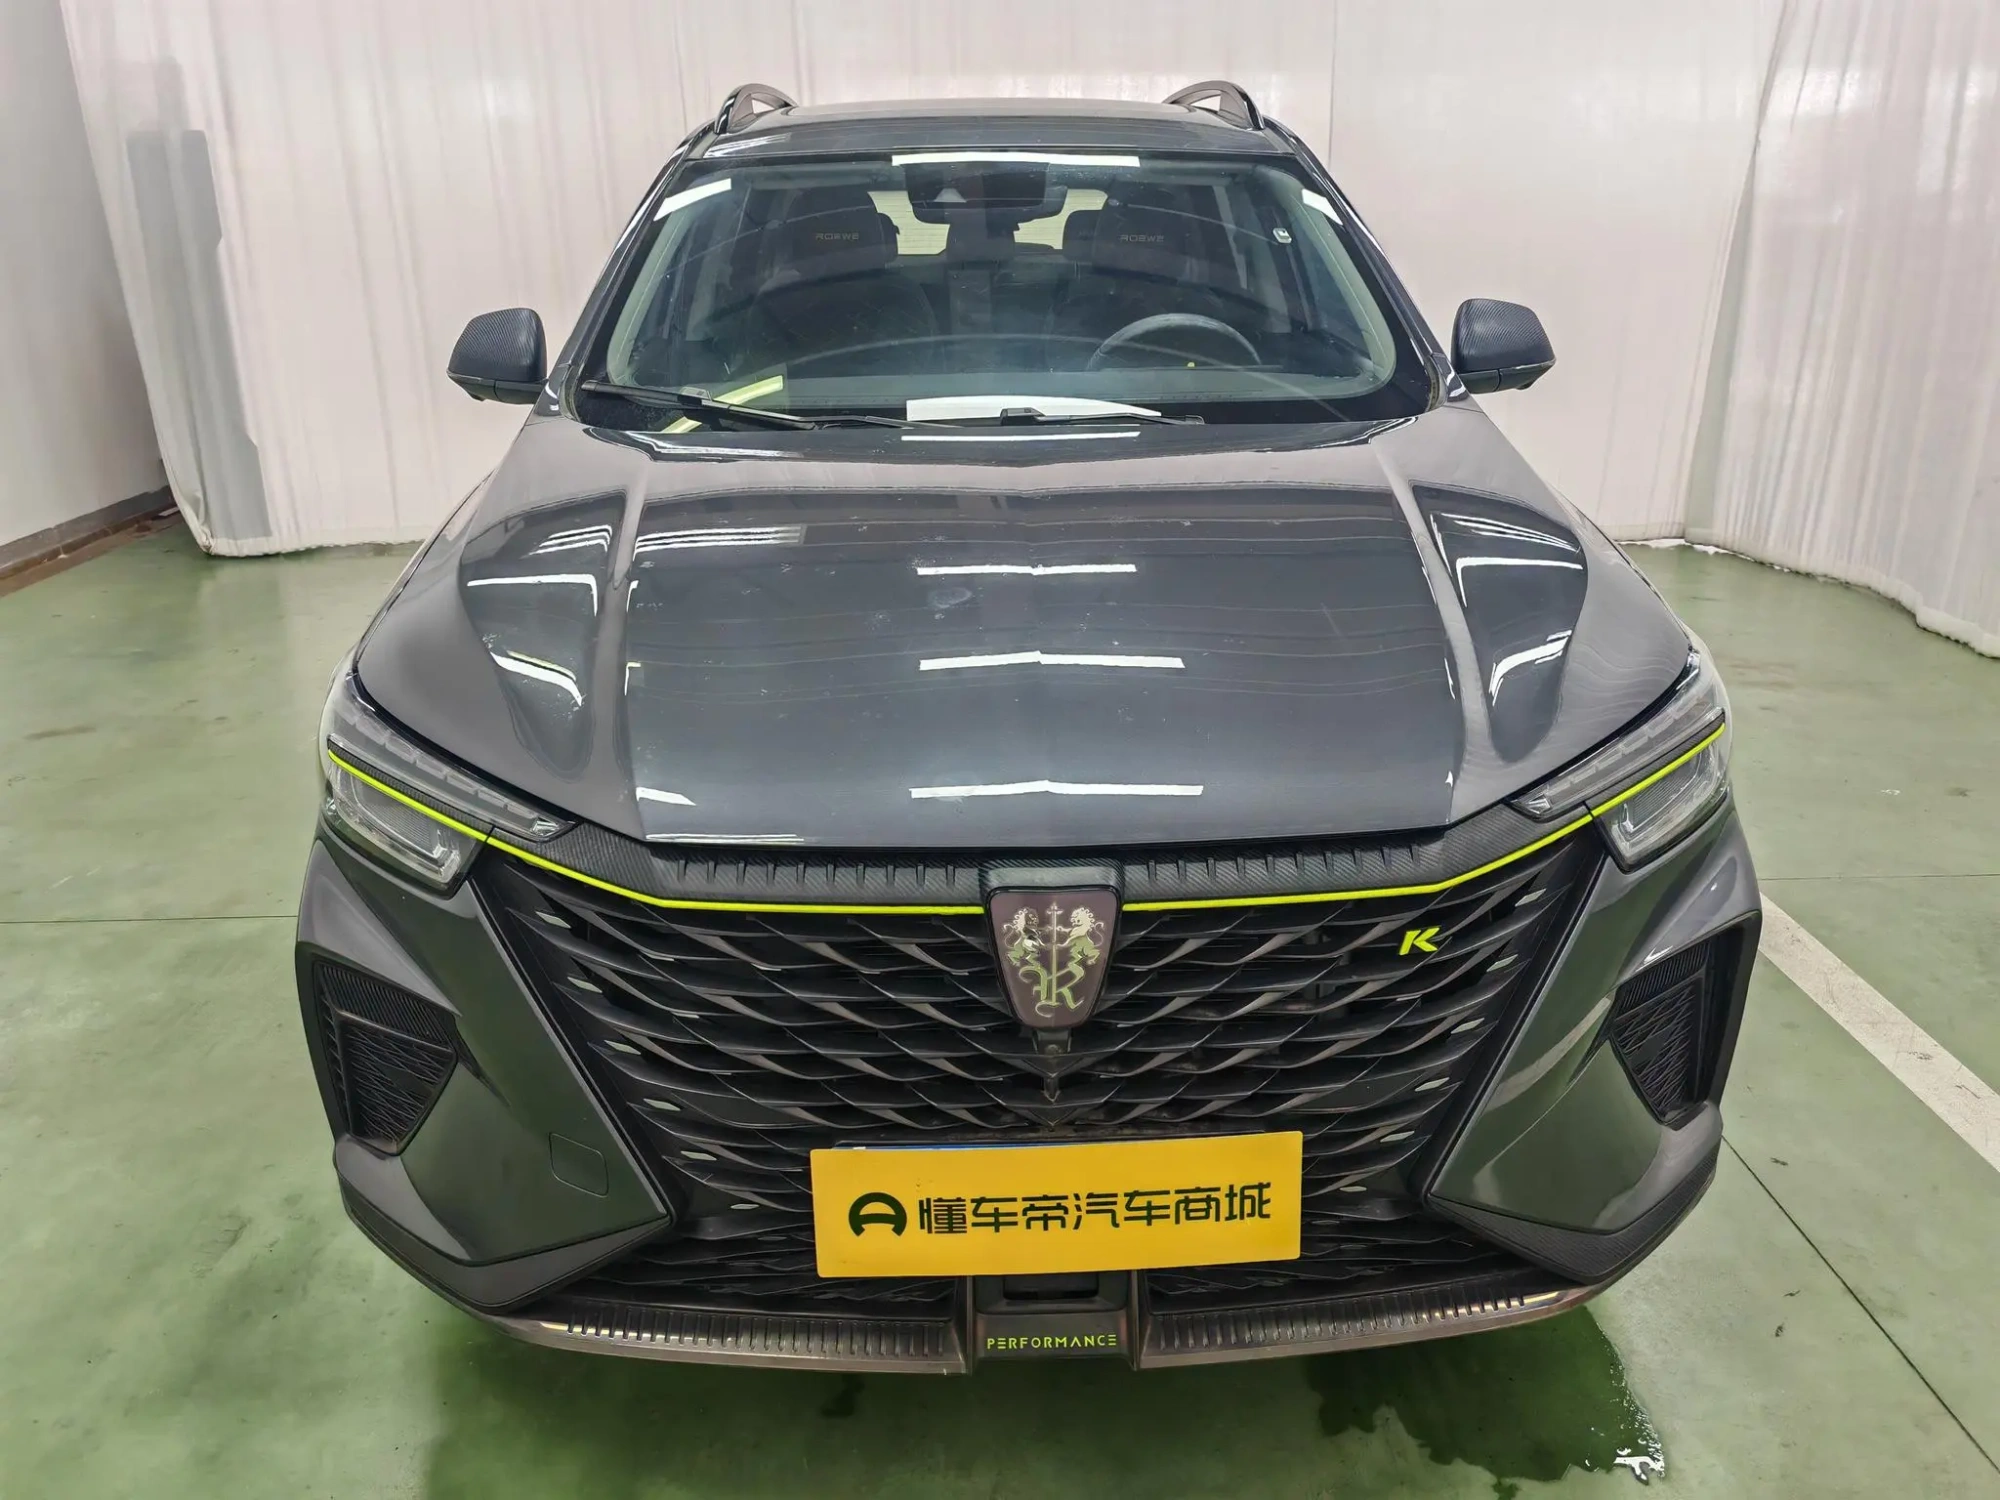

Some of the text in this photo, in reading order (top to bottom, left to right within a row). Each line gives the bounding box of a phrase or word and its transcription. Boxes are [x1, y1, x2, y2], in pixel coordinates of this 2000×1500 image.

[1399, 926, 1439, 956] K
[918, 1181, 1272, 1235] 懂车帝汽车商城
[986, 1334, 1117, 1350] PERFORMANCE
